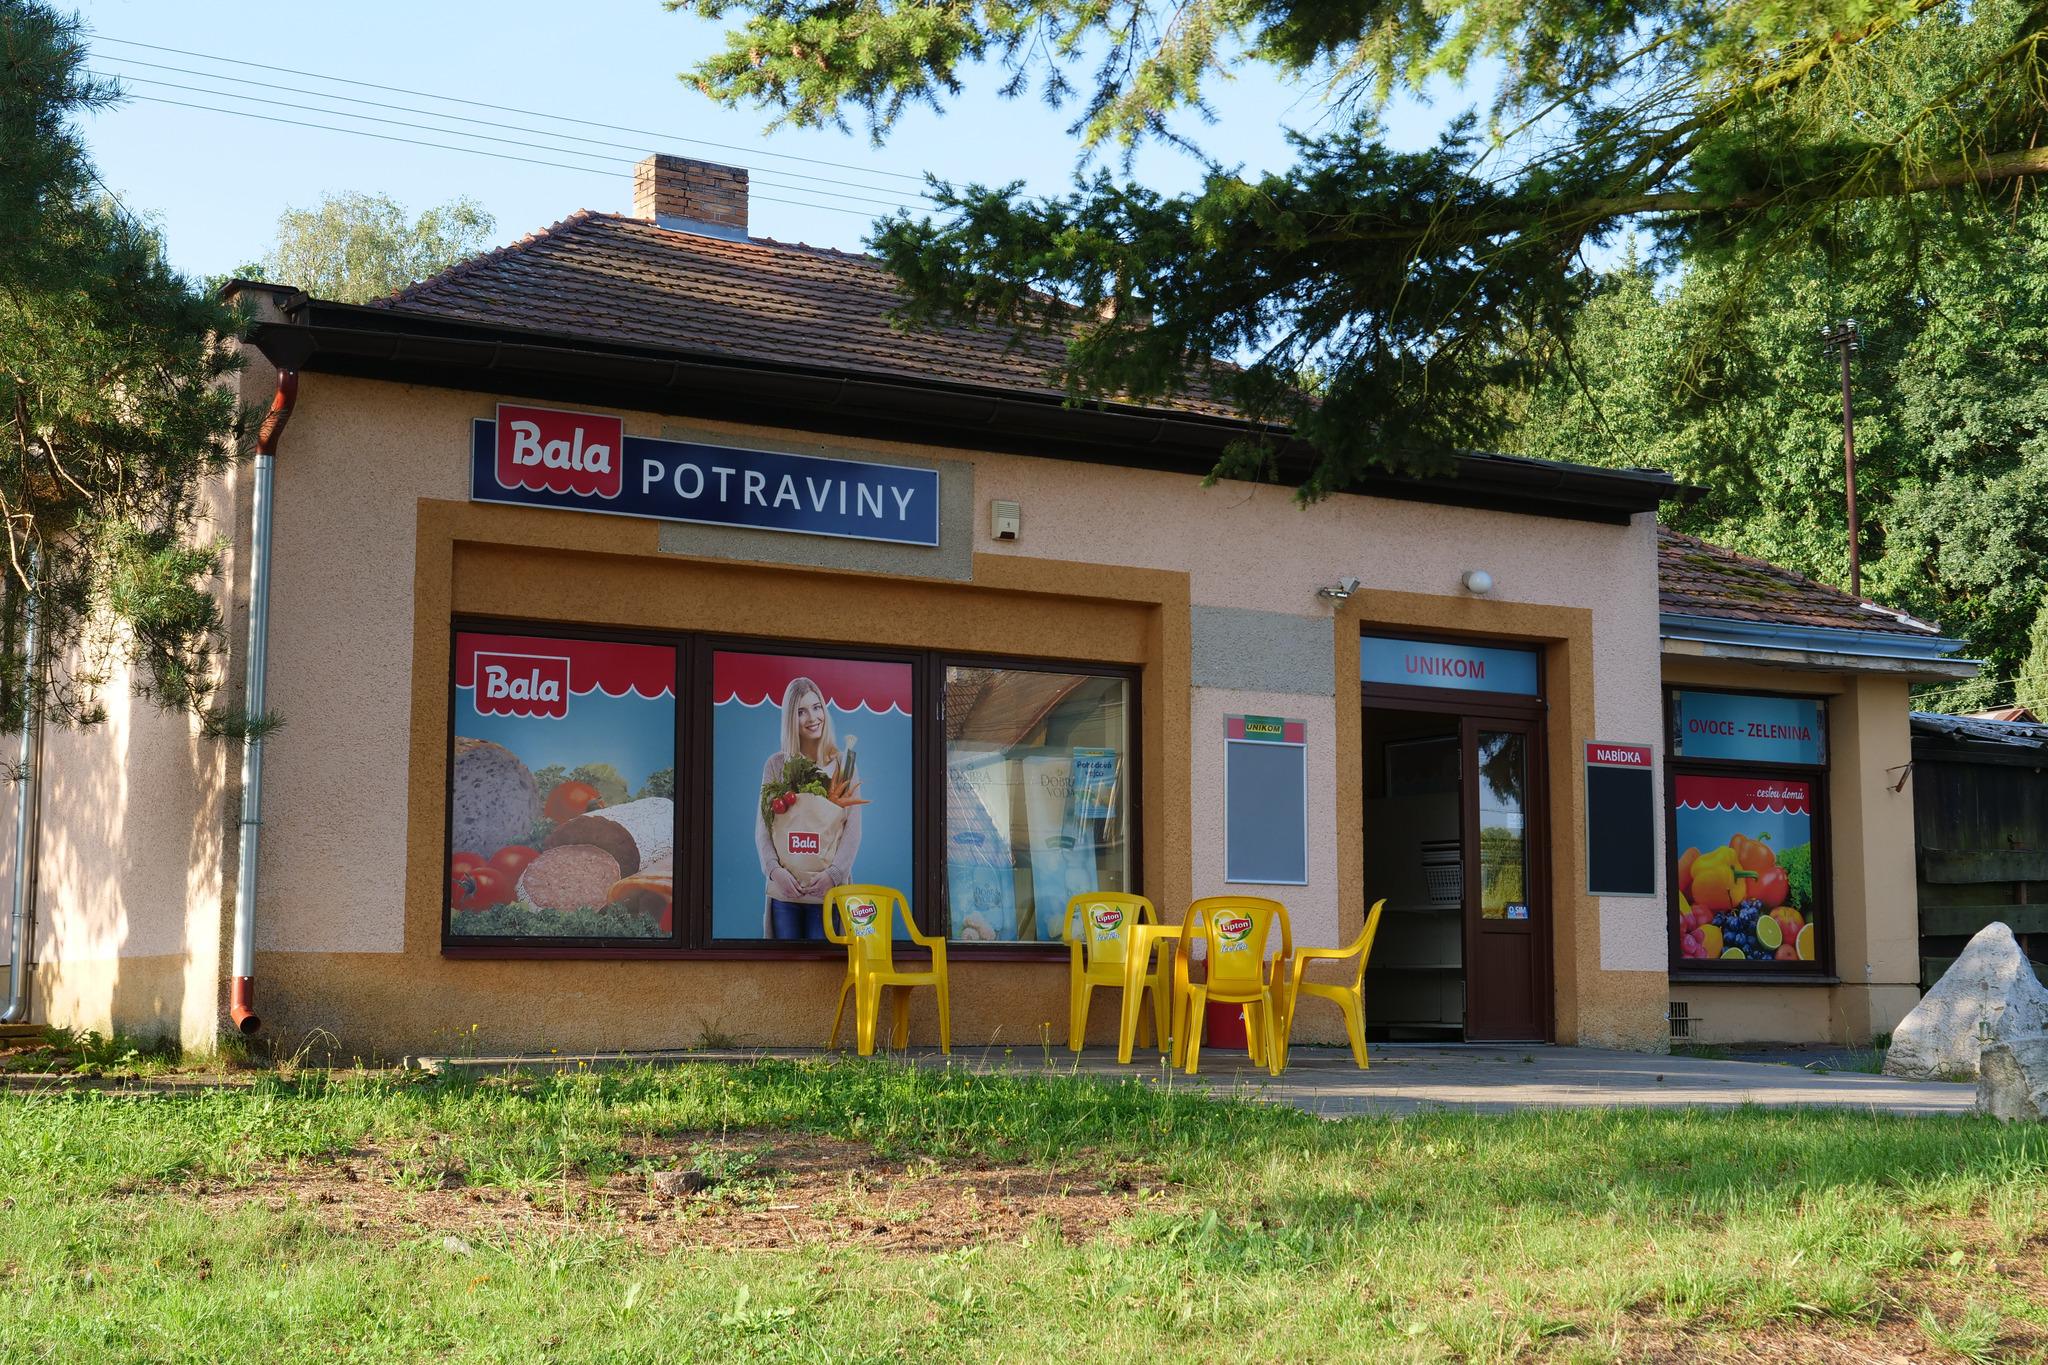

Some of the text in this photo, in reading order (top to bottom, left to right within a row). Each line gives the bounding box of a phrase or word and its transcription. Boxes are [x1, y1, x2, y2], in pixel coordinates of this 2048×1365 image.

[511, 420, 611, 474] Bala
[642, 459, 915, 521] POTRAVINY
[1405, 654, 1485, 679] UNIKOM
[485, 665, 561, 702] Bala
[1246, 724, 1281, 732] UNIKOM
[1689, 719, 1734, 735] OVOCE
[1747, 723, 1811, 741] ZELENINA
[1597, 749, 1641, 763] NABÍDKA
[791, 836, 817, 849] Bala
[853, 907, 874, 917] Lipton
[1097, 913, 1119, 922] Lipton
[1222, 921, 1249, 931] Lipton
